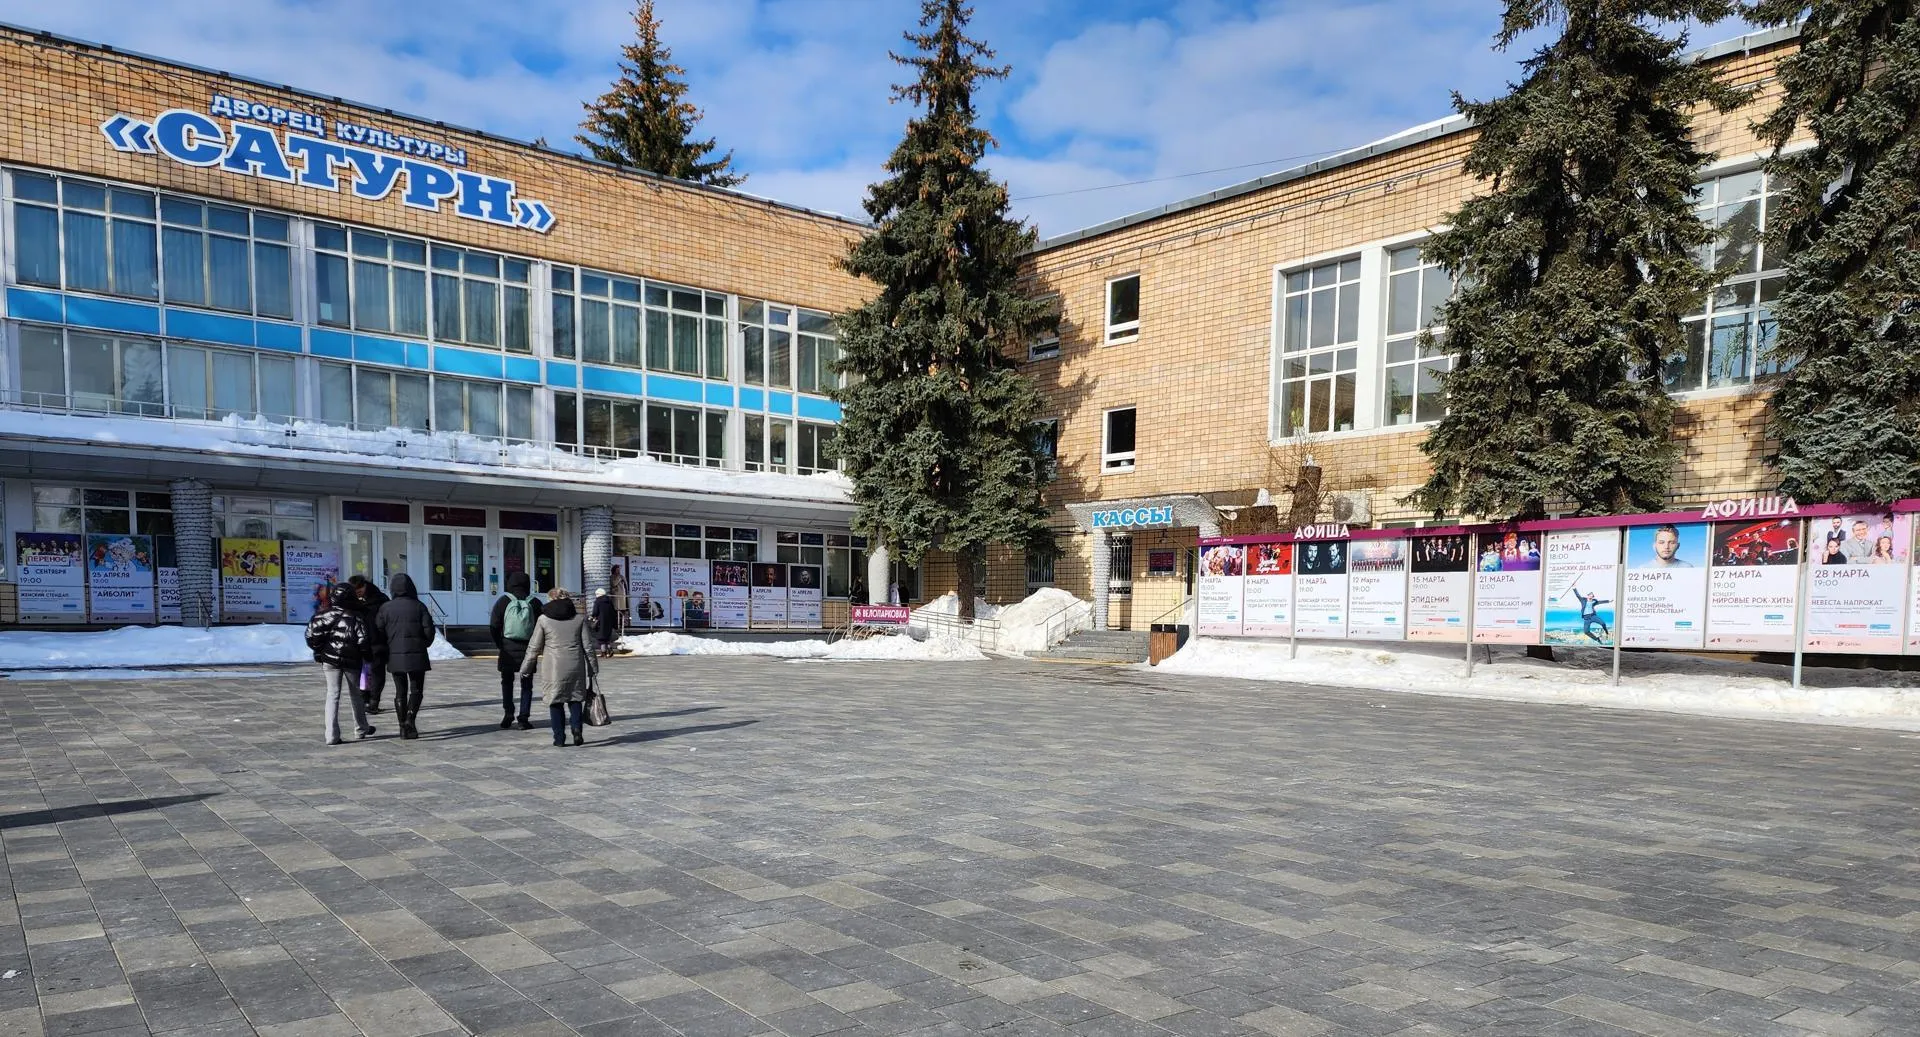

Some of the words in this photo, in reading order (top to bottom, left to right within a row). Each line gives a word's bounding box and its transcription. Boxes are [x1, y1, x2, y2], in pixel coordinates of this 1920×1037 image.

[211, 94, 325, 137] ДВОРЕЦ
[336, 122, 468, 167] КУЛЬТУРЫ
[1701, 496, 1799, 519] АФИША
[1092, 505, 1172, 528] КАССЫ
[1294, 524, 1350, 540] АФИША
[1550, 543, 1559, 551] 21
[1561, 543, 1591, 551] МАРТА
[27, 555, 67, 563] ПЕРЕНОС
[23, 567, 29, 575] 5
[1714, 571, 1726, 579] 27
[1729, 570, 1762, 578] МАРТА
[1815, 570, 1829, 578] 28
[1833, 569, 1870, 578] МАРТА
[1814, 579, 1839, 587] 19:00
[1410, 596, 1449, 604] ЭПИДЕМИЯ
[862, 609, 907, 618] ВЕЛОПАРКОВКА
